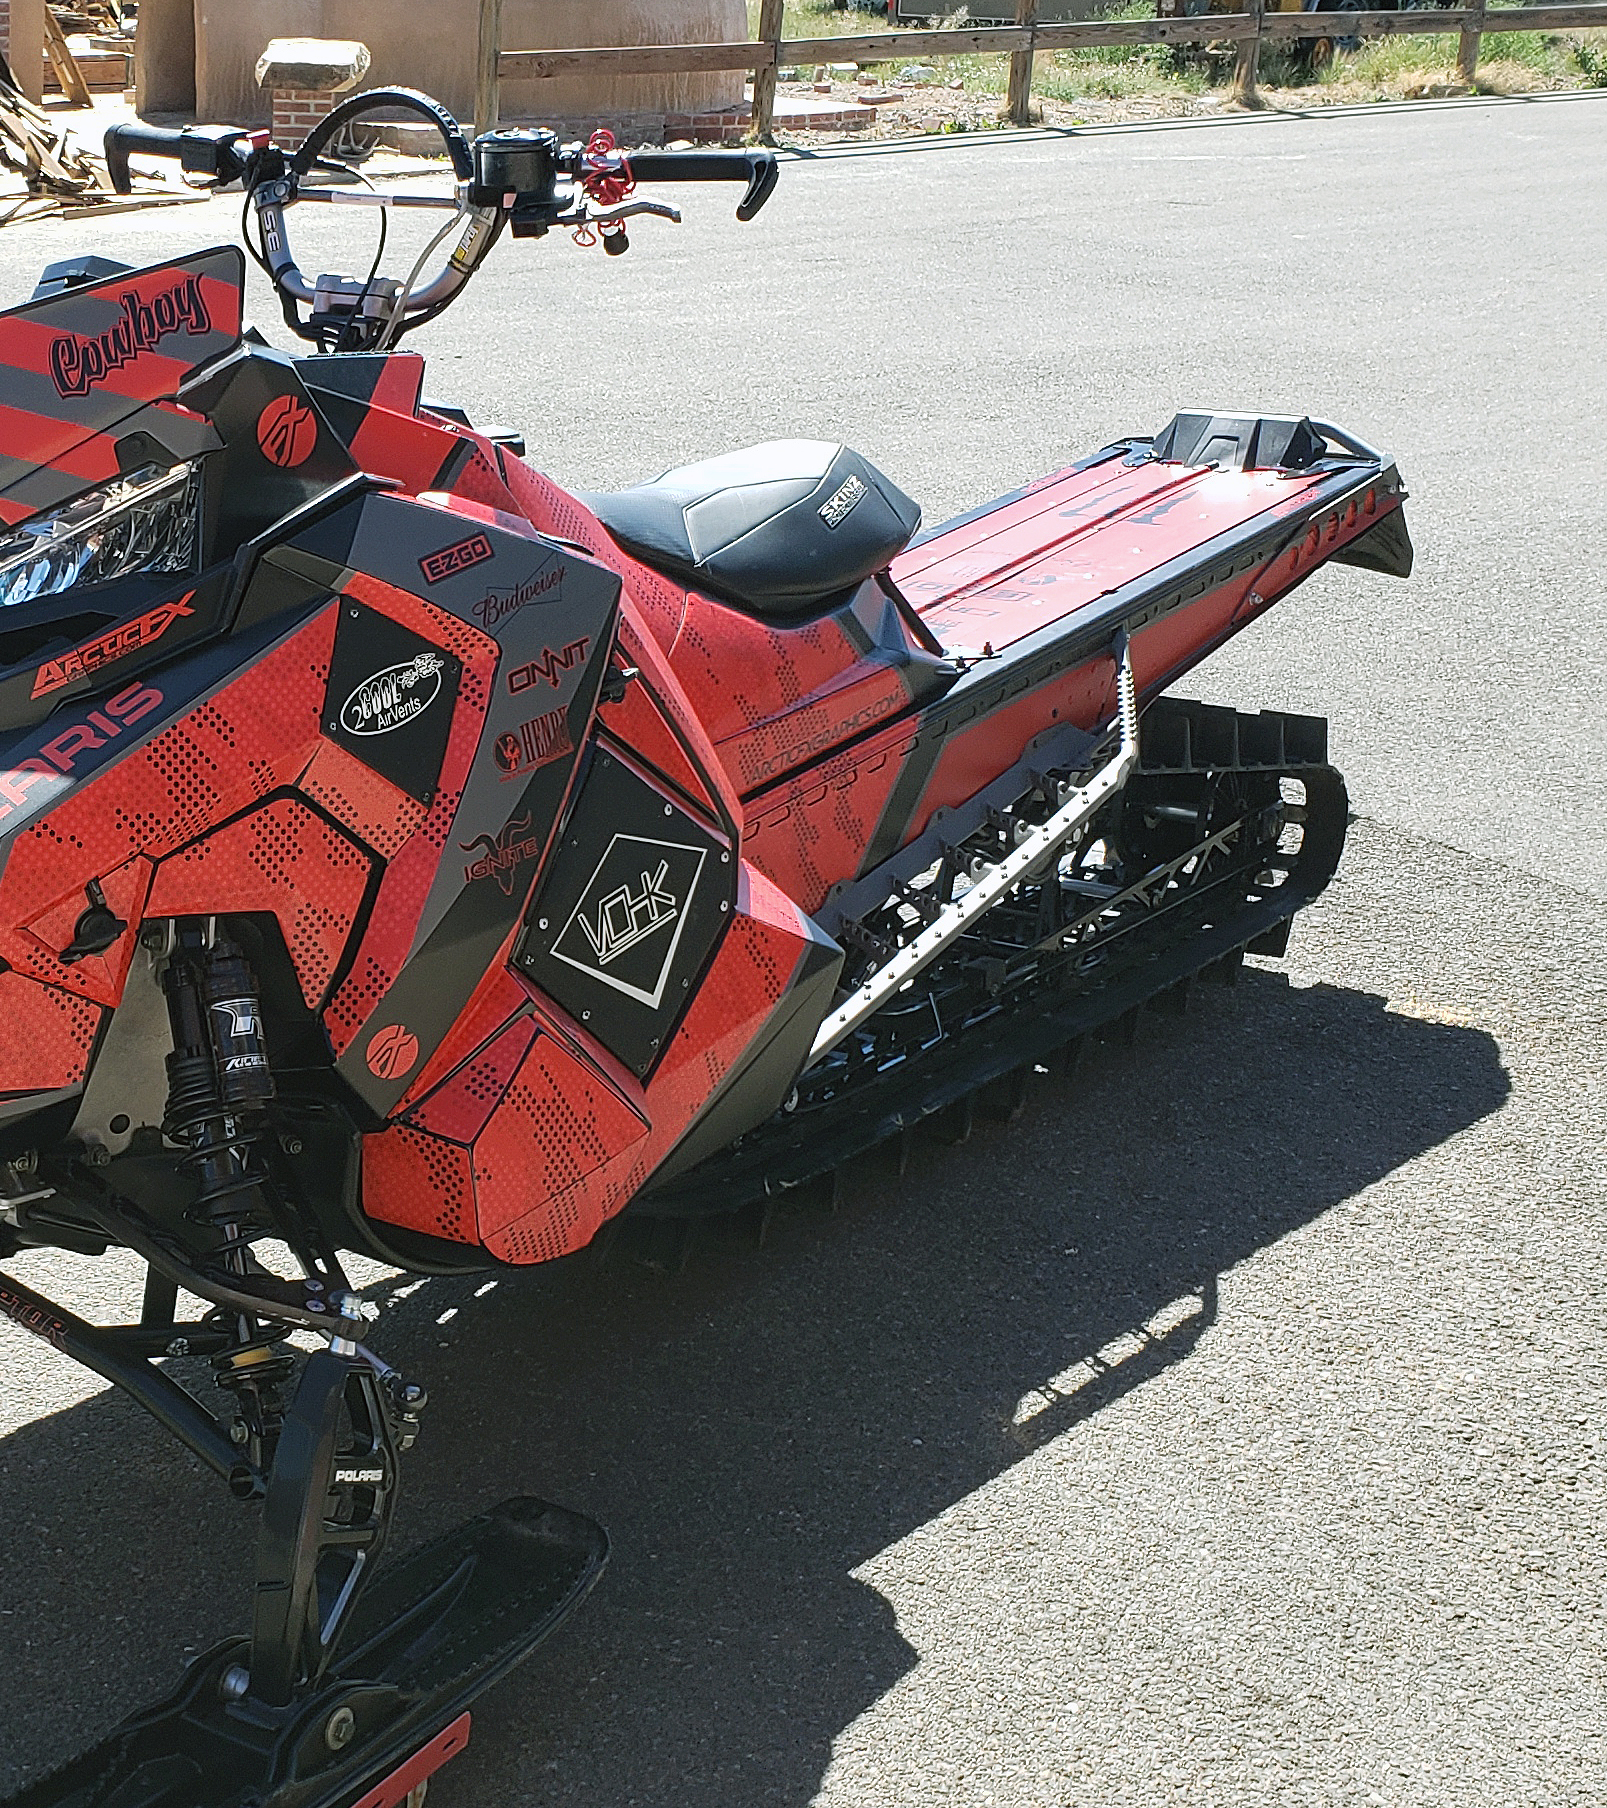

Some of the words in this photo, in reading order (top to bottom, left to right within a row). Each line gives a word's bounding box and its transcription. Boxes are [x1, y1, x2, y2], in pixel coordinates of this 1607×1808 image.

[49, 272, 211, 399] Cowboy
[820, 476, 862, 522] SKINZ
[472, 566, 566, 627] Budweiser
[508, 637, 590, 693] ONNIT
[377, 697, 422, 729] AirVents
[463, 836, 538, 883] IGNITE
[335, 1470, 383, 1482] POLARIS
